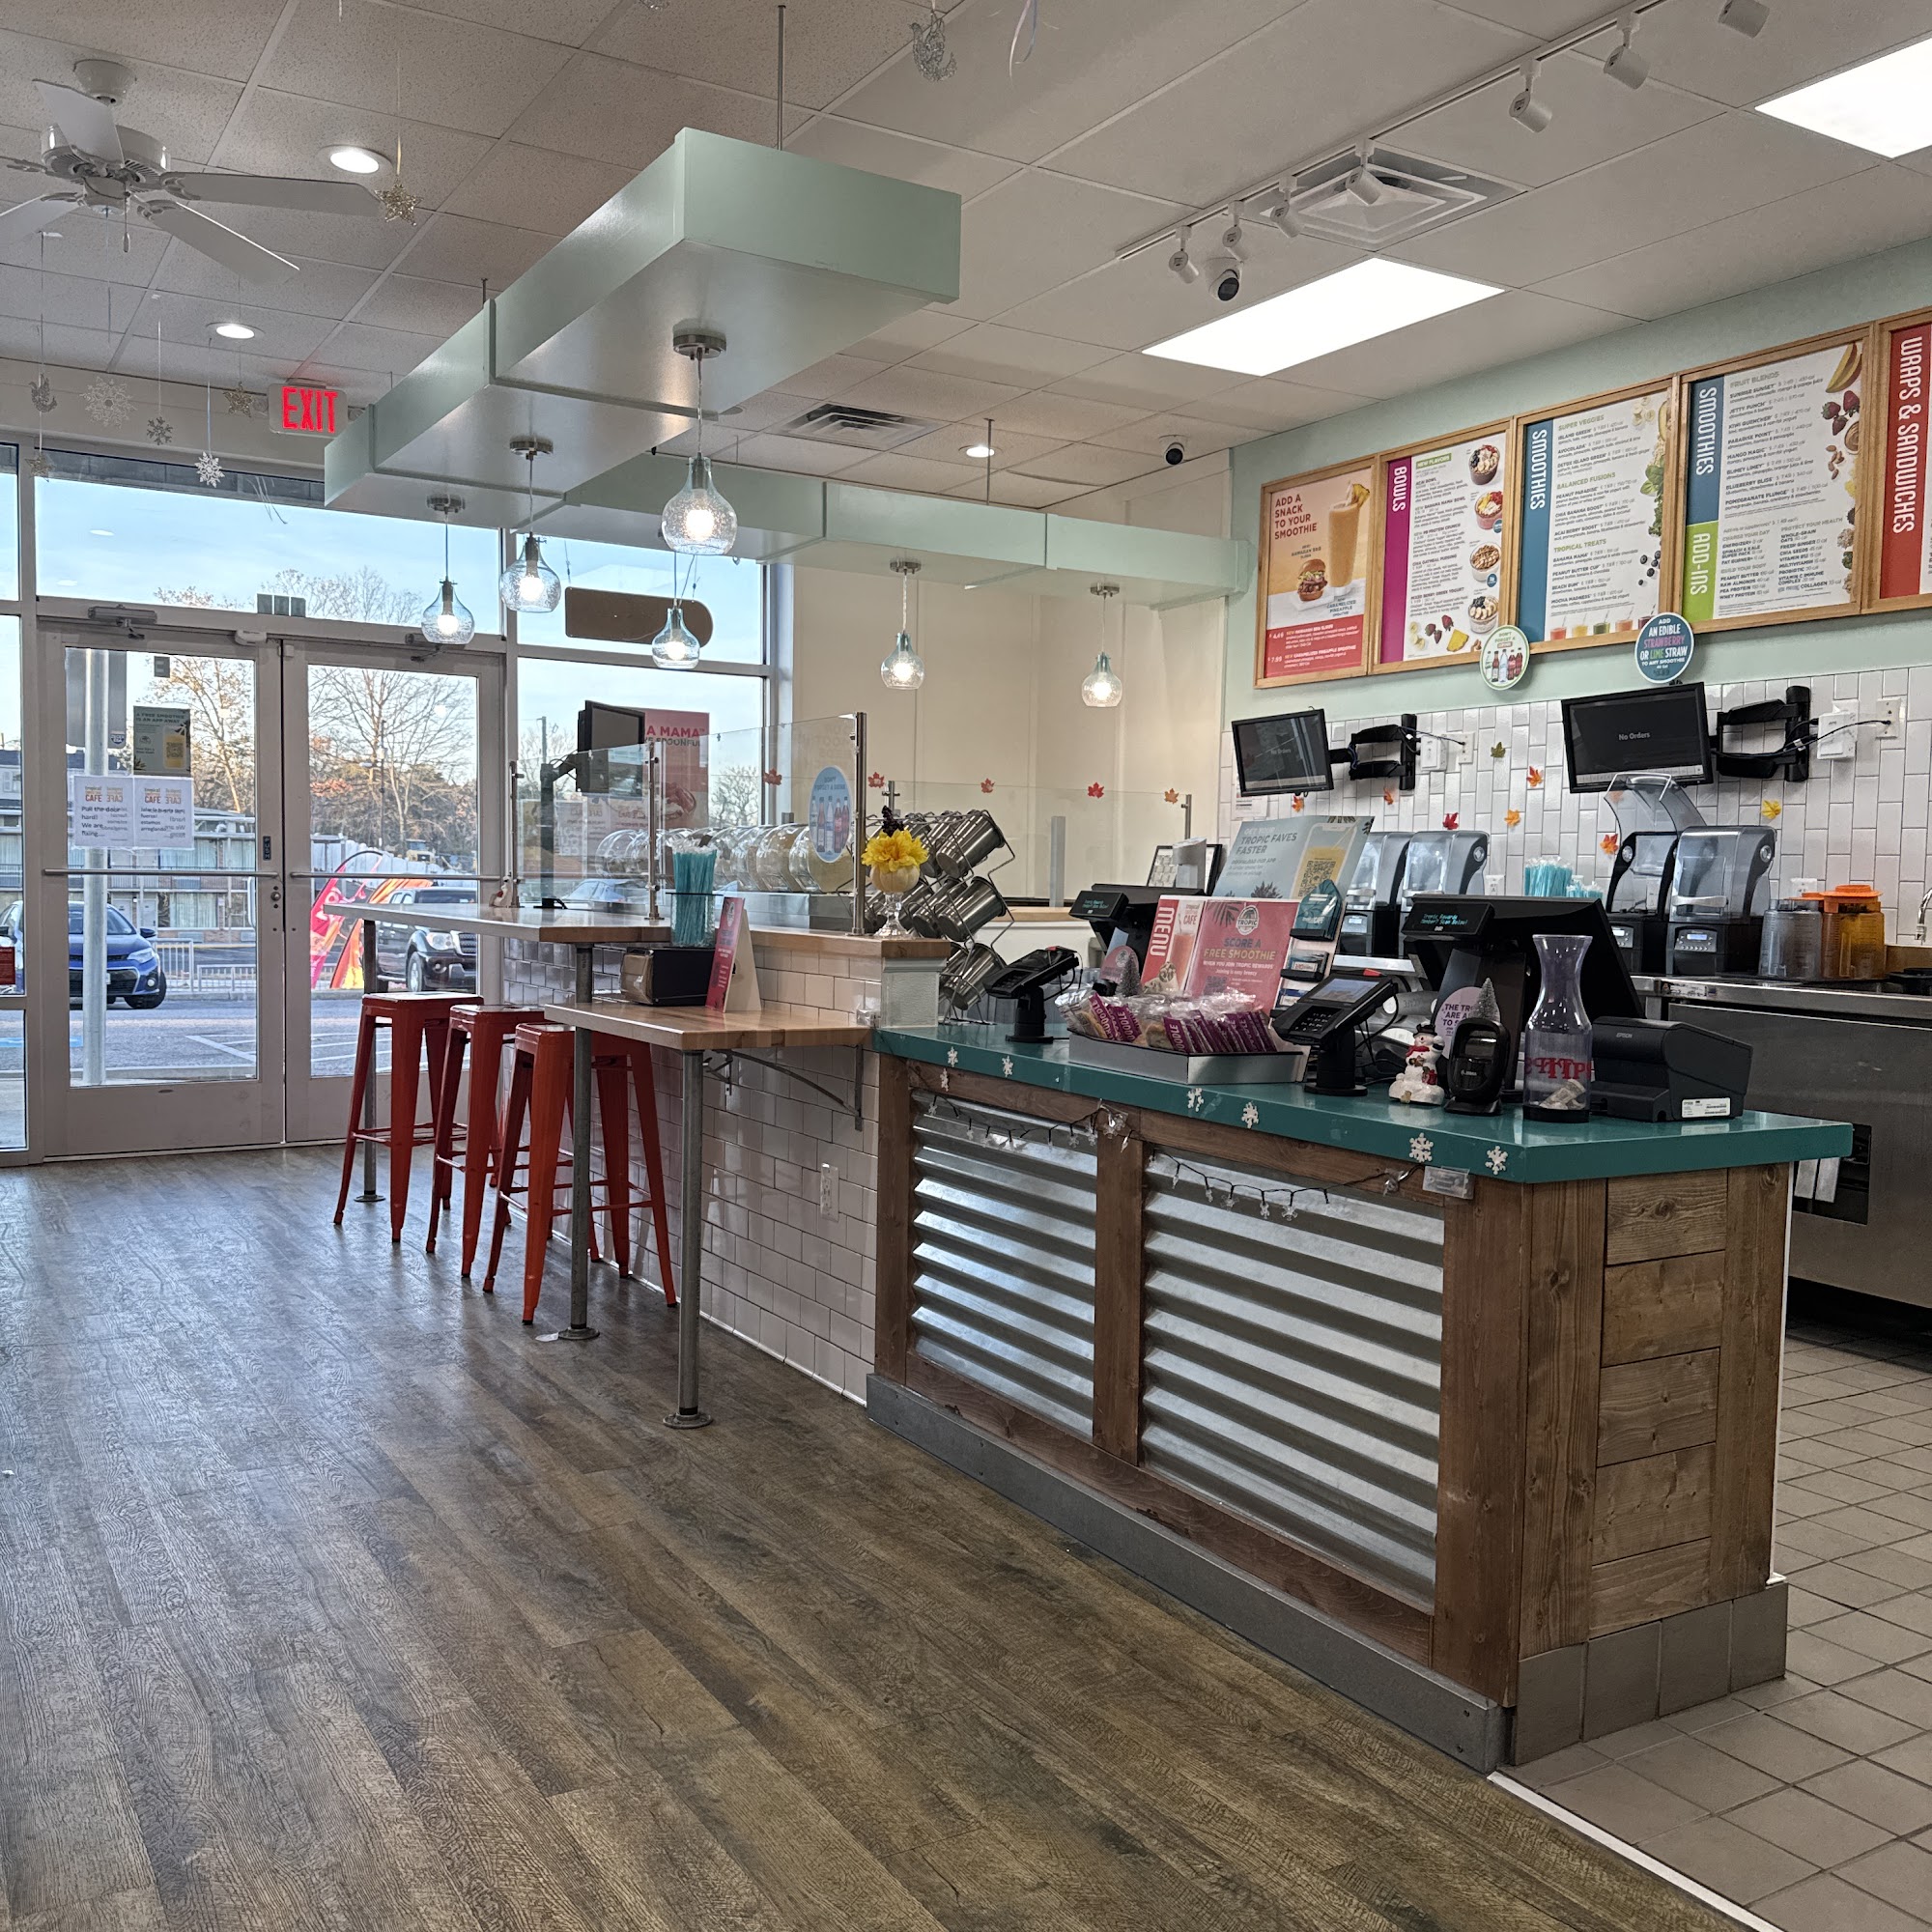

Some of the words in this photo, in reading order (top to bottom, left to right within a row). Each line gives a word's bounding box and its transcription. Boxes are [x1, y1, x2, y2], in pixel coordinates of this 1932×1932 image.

[1899, 337, 1922, 401] WRAPS
[1730, 378, 1750, 387] FRUIT
[1751, 371, 1779, 383] BLENDS
[282, 386, 338, 434] EXIT
[1898, 404, 1921, 420] &
[1558, 422, 1577, 431] SUPER
[1579, 415, 1605, 426] VEGGIES
[1696, 387, 1718, 476] SMOOTHIES
[1530, 430, 1548, 510] SMOOTHIES
[1893, 422, 1919, 533] SANDWICHES
[1557, 477, 1588, 490] BALANCED
[1590, 471, 1615, 482] FUSIONS
[1393, 467, 1406, 512] BOWLS
[1575, 487, 1597, 496] PARADISE
[1275, 497, 1293, 508] ADD
[1275, 504, 1303, 518] SNACK
[1289, 514, 1311, 526] YOUR
[1275, 524, 1317, 540] SMOOTHIE
[1554, 543, 1582, 554] TROPICAL
[1584, 538, 1605, 548] TREATS
[1690, 533, 1710, 595] ADD-INS
[1649, 627, 1658, 637] AN
[1659, 624, 1681, 636] EDIBLE
[1644, 636, 1685, 649] STRAWBERRY
[1640, 650, 1649, 661] OR
[1650, 649, 1663, 659] LIME
[1665, 646, 1688, 658] STRAW
[1241, 836, 1269, 845] TROPIC
[1271, 833, 1297, 842] FAVES
[1236, 845, 1267, 855] FASTER
[1183, 915, 1197, 925] CAFE
[1150, 907, 1175, 956] MENU
[1224, 939, 1253, 948] SCORE
[1255, 939, 1261, 948] A
[1204, 949, 1227, 958] FREE
[1229, 950, 1276, 960] SMOOTHIE
